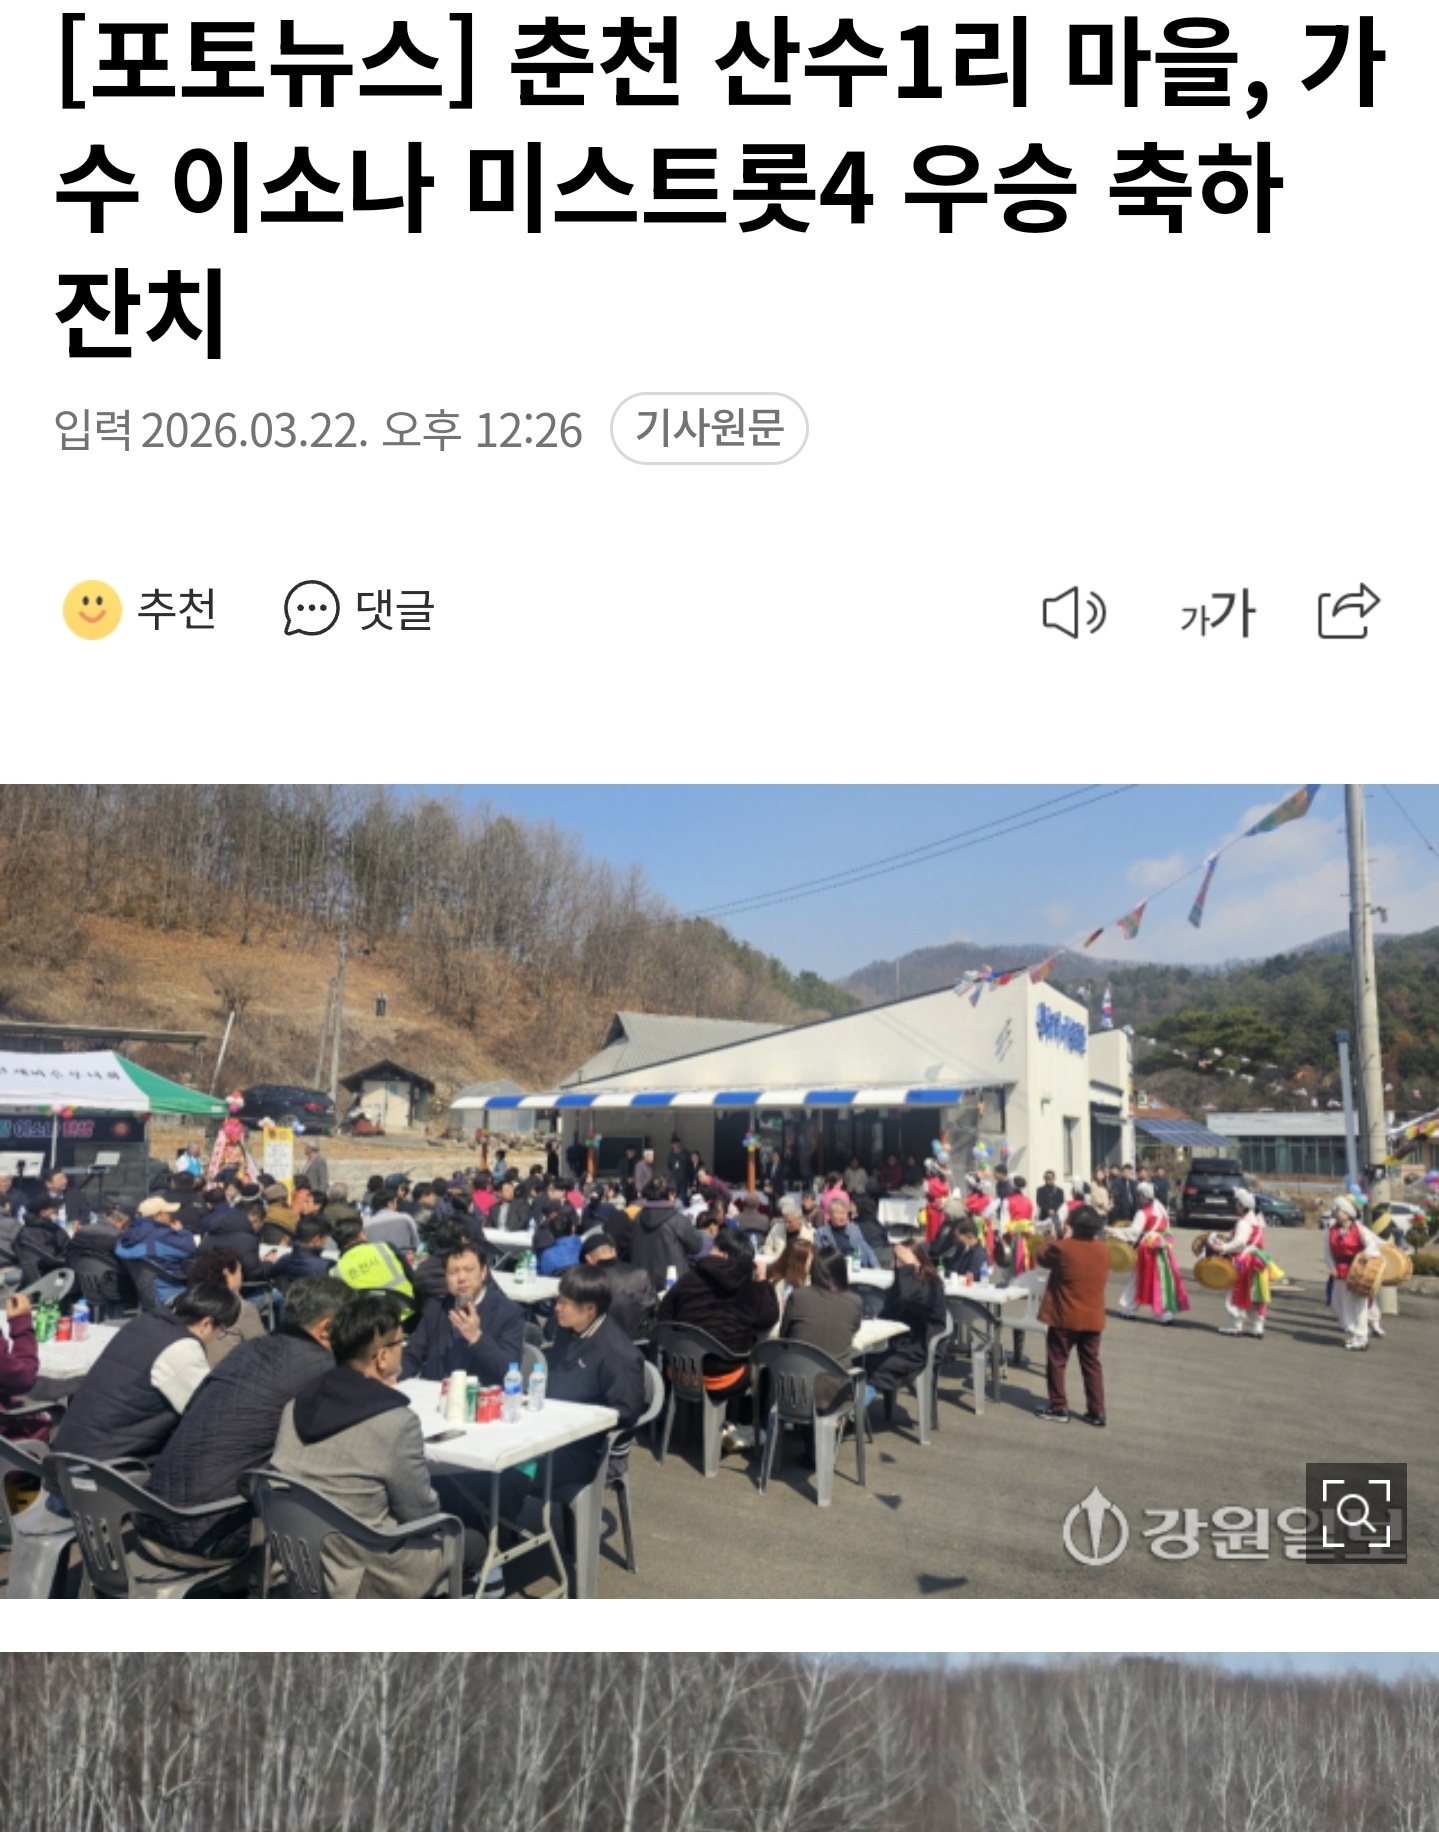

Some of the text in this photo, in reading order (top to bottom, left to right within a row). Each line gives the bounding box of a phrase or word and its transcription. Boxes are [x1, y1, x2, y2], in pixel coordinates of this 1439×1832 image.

[62, 13, 1386, 120] [포토뉴스] 춘천 산수1리 마을, 가
[56, 142, 1283, 233] 수 이소나 미스트롯4 우승 축하
[55, 268, 221, 359] 잔치
[56, 409, 582, 451] 입력 2026.03.22. 오후 12:26
[637, 408, 784, 447] 기사원문
[138, 588, 214, 630] 추천
[358, 589, 434, 630] 댓글
